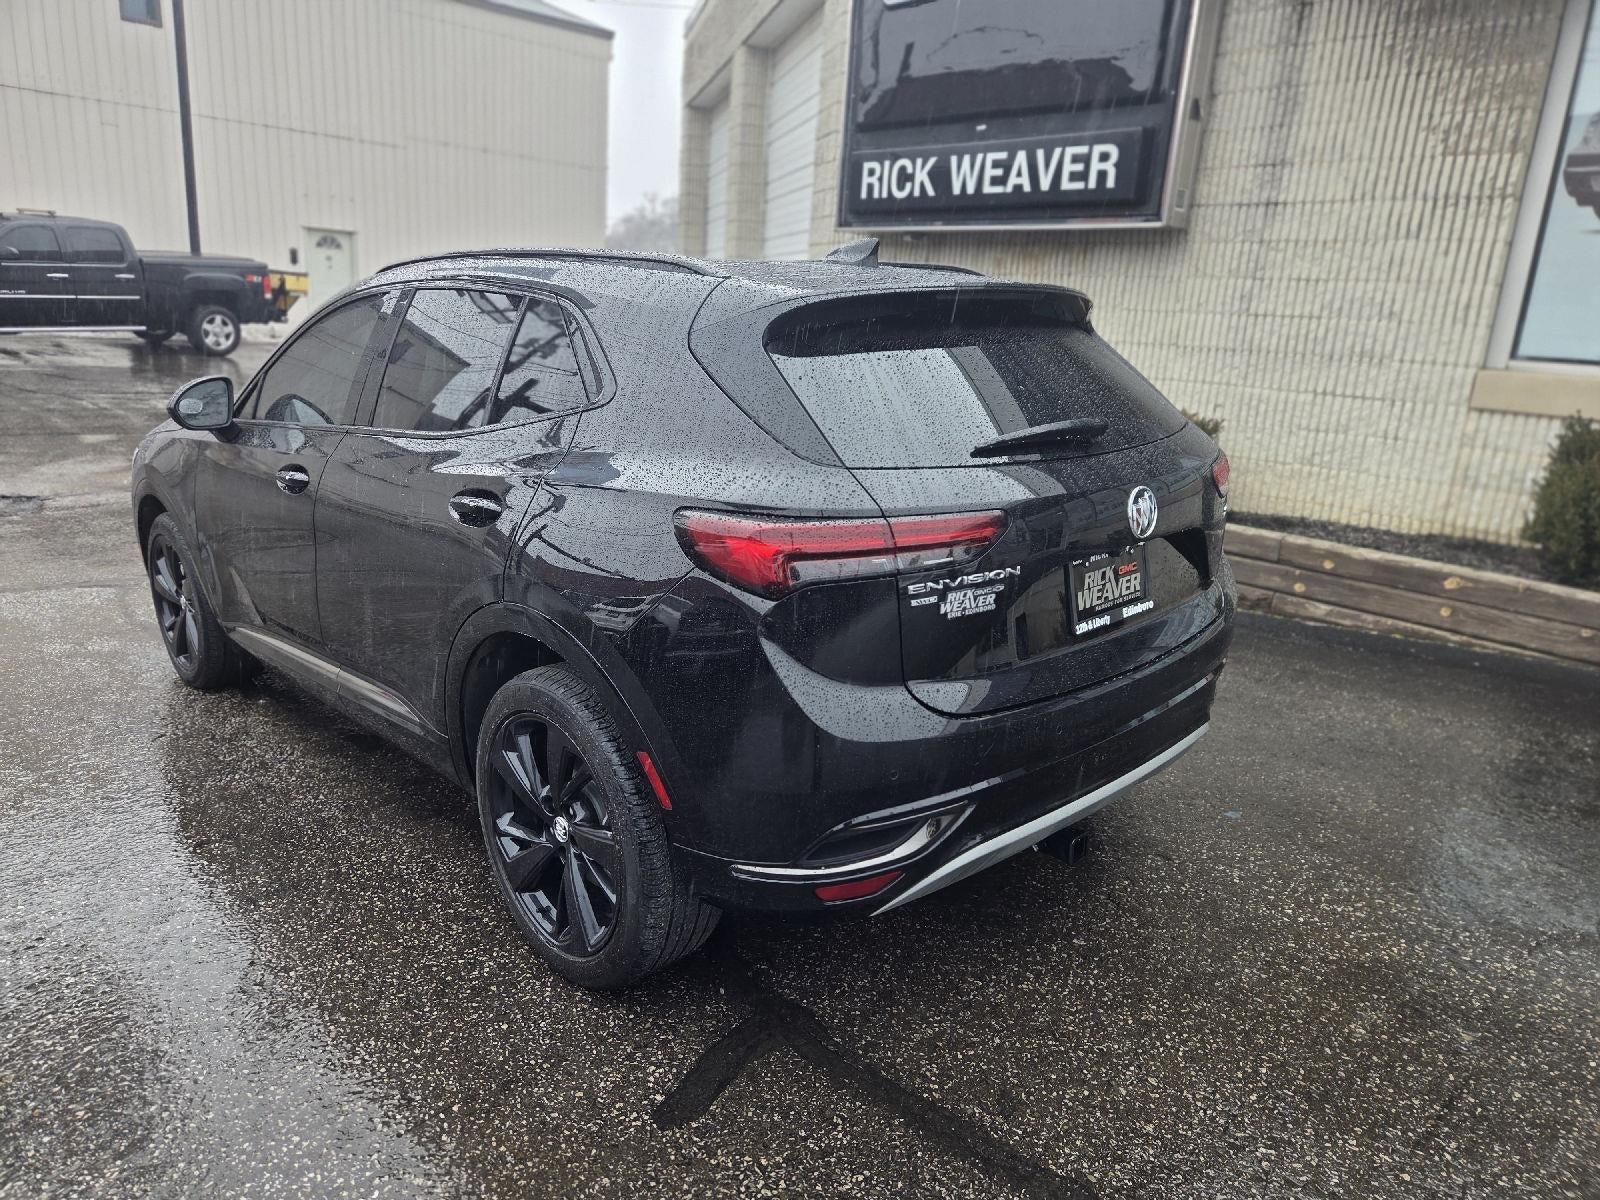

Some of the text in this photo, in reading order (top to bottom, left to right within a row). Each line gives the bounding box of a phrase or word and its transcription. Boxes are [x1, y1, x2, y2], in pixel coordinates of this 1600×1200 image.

[860, 143, 1120, 200] RICK WEAVER
[1084, 565, 1116, 590] RICK
[1119, 562, 1138, 575] GMC
[908, 566, 1021, 595] ENVISION
[1077, 573, 1141, 611] WEAVER
[940, 593, 996, 614] WEAVER
[946, 588, 975, 603] RICK
[1122, 600, 1154, 618] Edinboro
